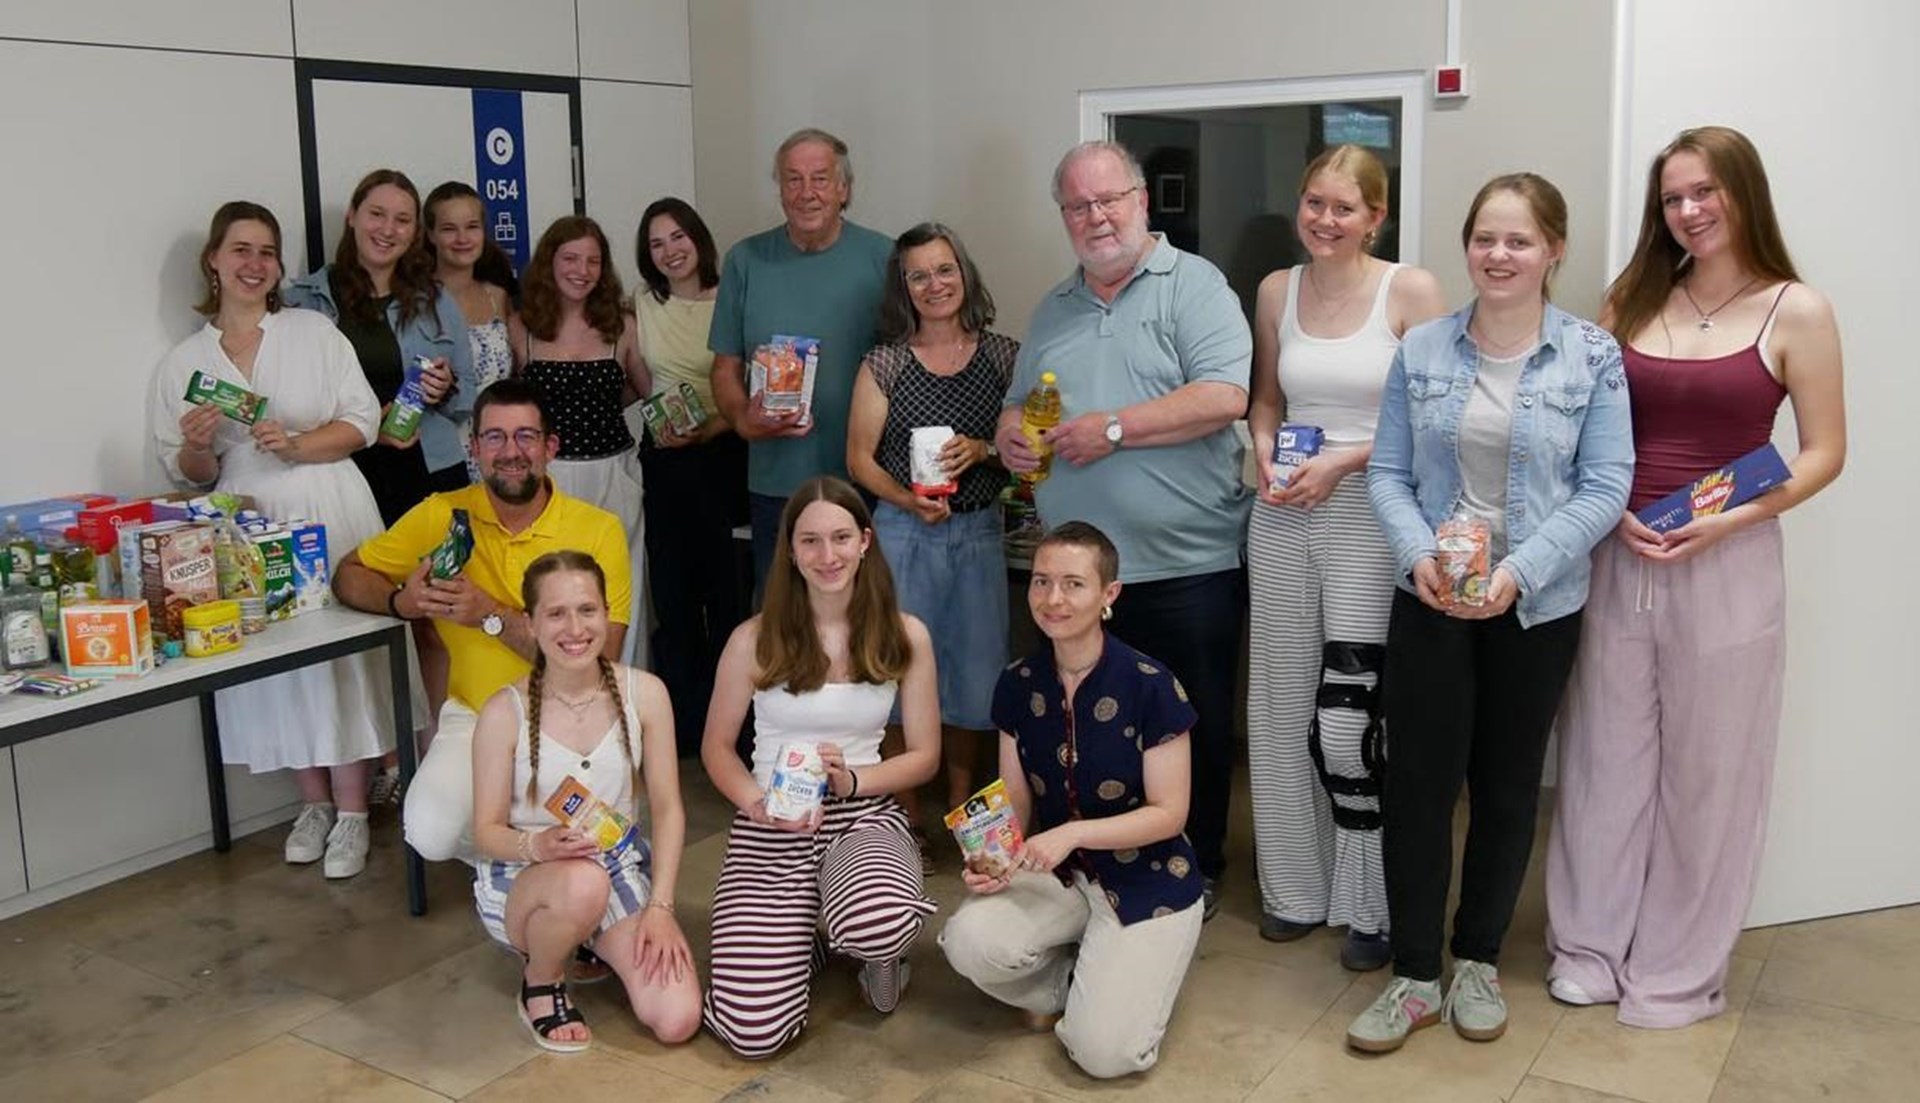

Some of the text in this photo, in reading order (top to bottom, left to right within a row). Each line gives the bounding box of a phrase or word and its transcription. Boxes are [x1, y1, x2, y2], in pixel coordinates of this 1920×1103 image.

[493, 136, 507, 157] C
[486, 179, 519, 200] 054
[1694, 486, 1729, 508] Barilla
[169, 558, 211, 581] KNUSPER
